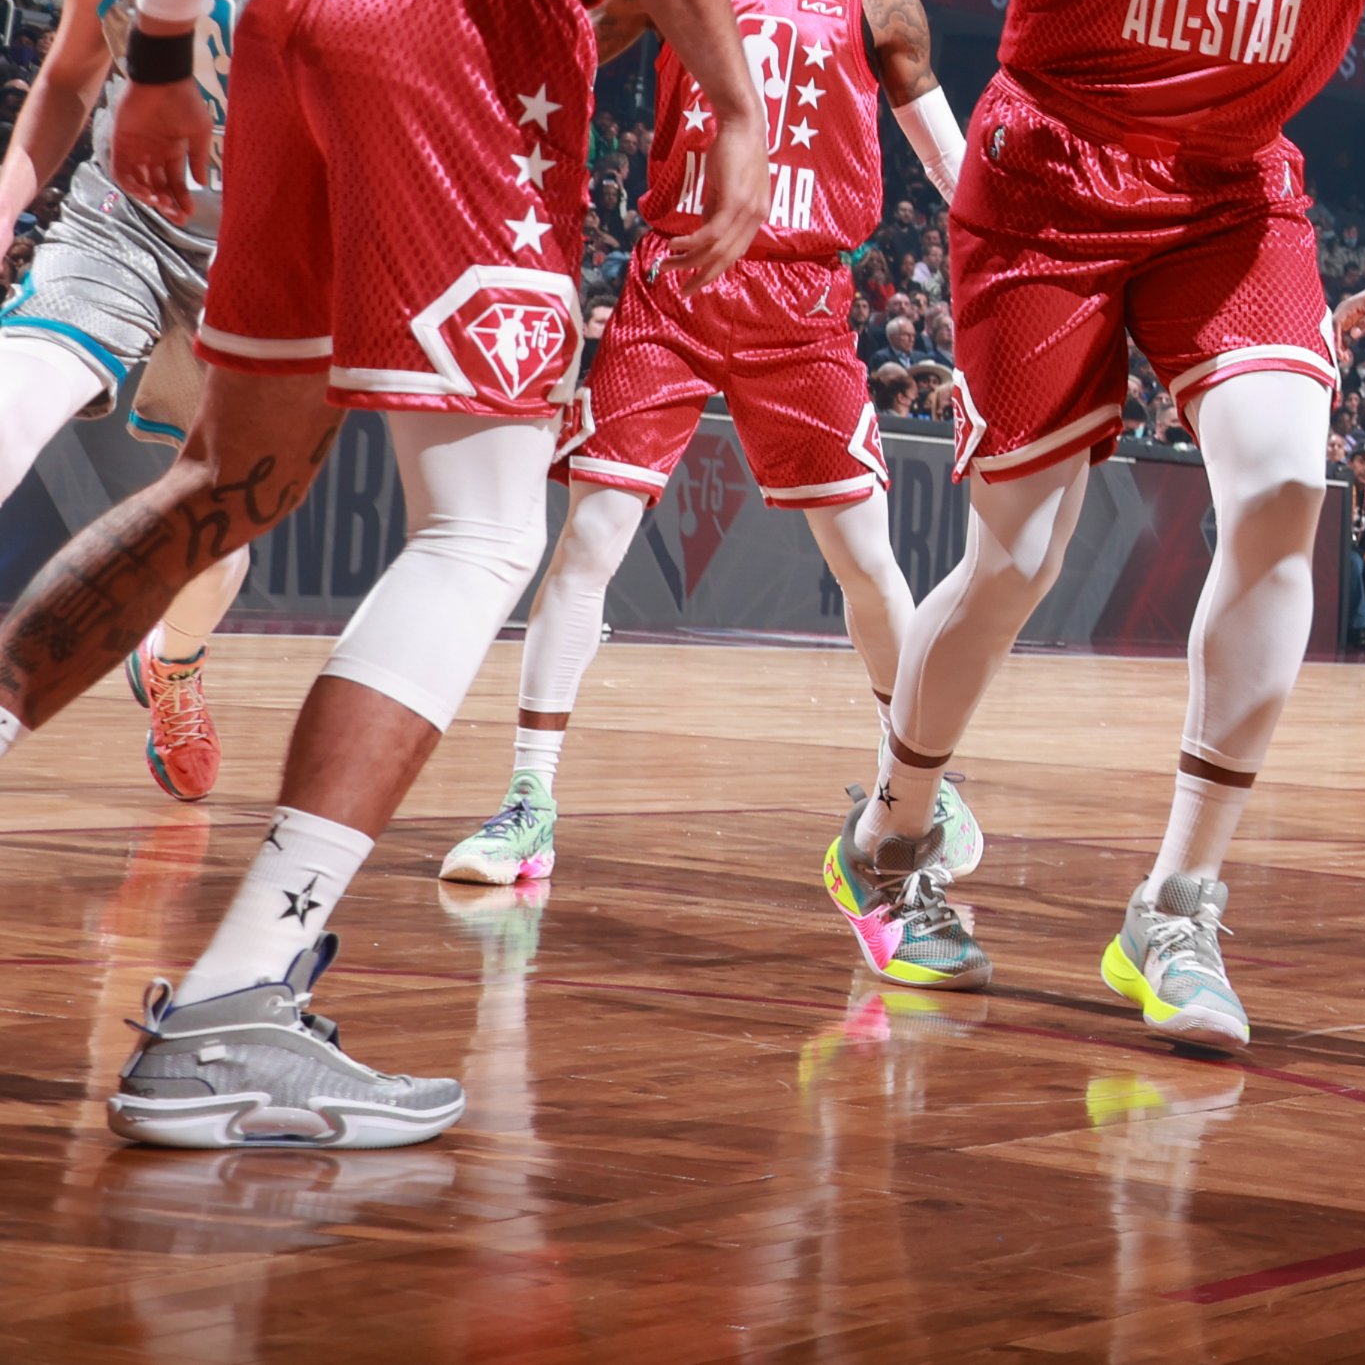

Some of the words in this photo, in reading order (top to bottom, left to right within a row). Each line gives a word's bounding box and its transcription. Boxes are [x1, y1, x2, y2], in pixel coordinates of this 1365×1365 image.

[676, 150, 816, 230] ALTAR
[530, 320, 551, 350] 75
[699, 458, 724, 512] 75
